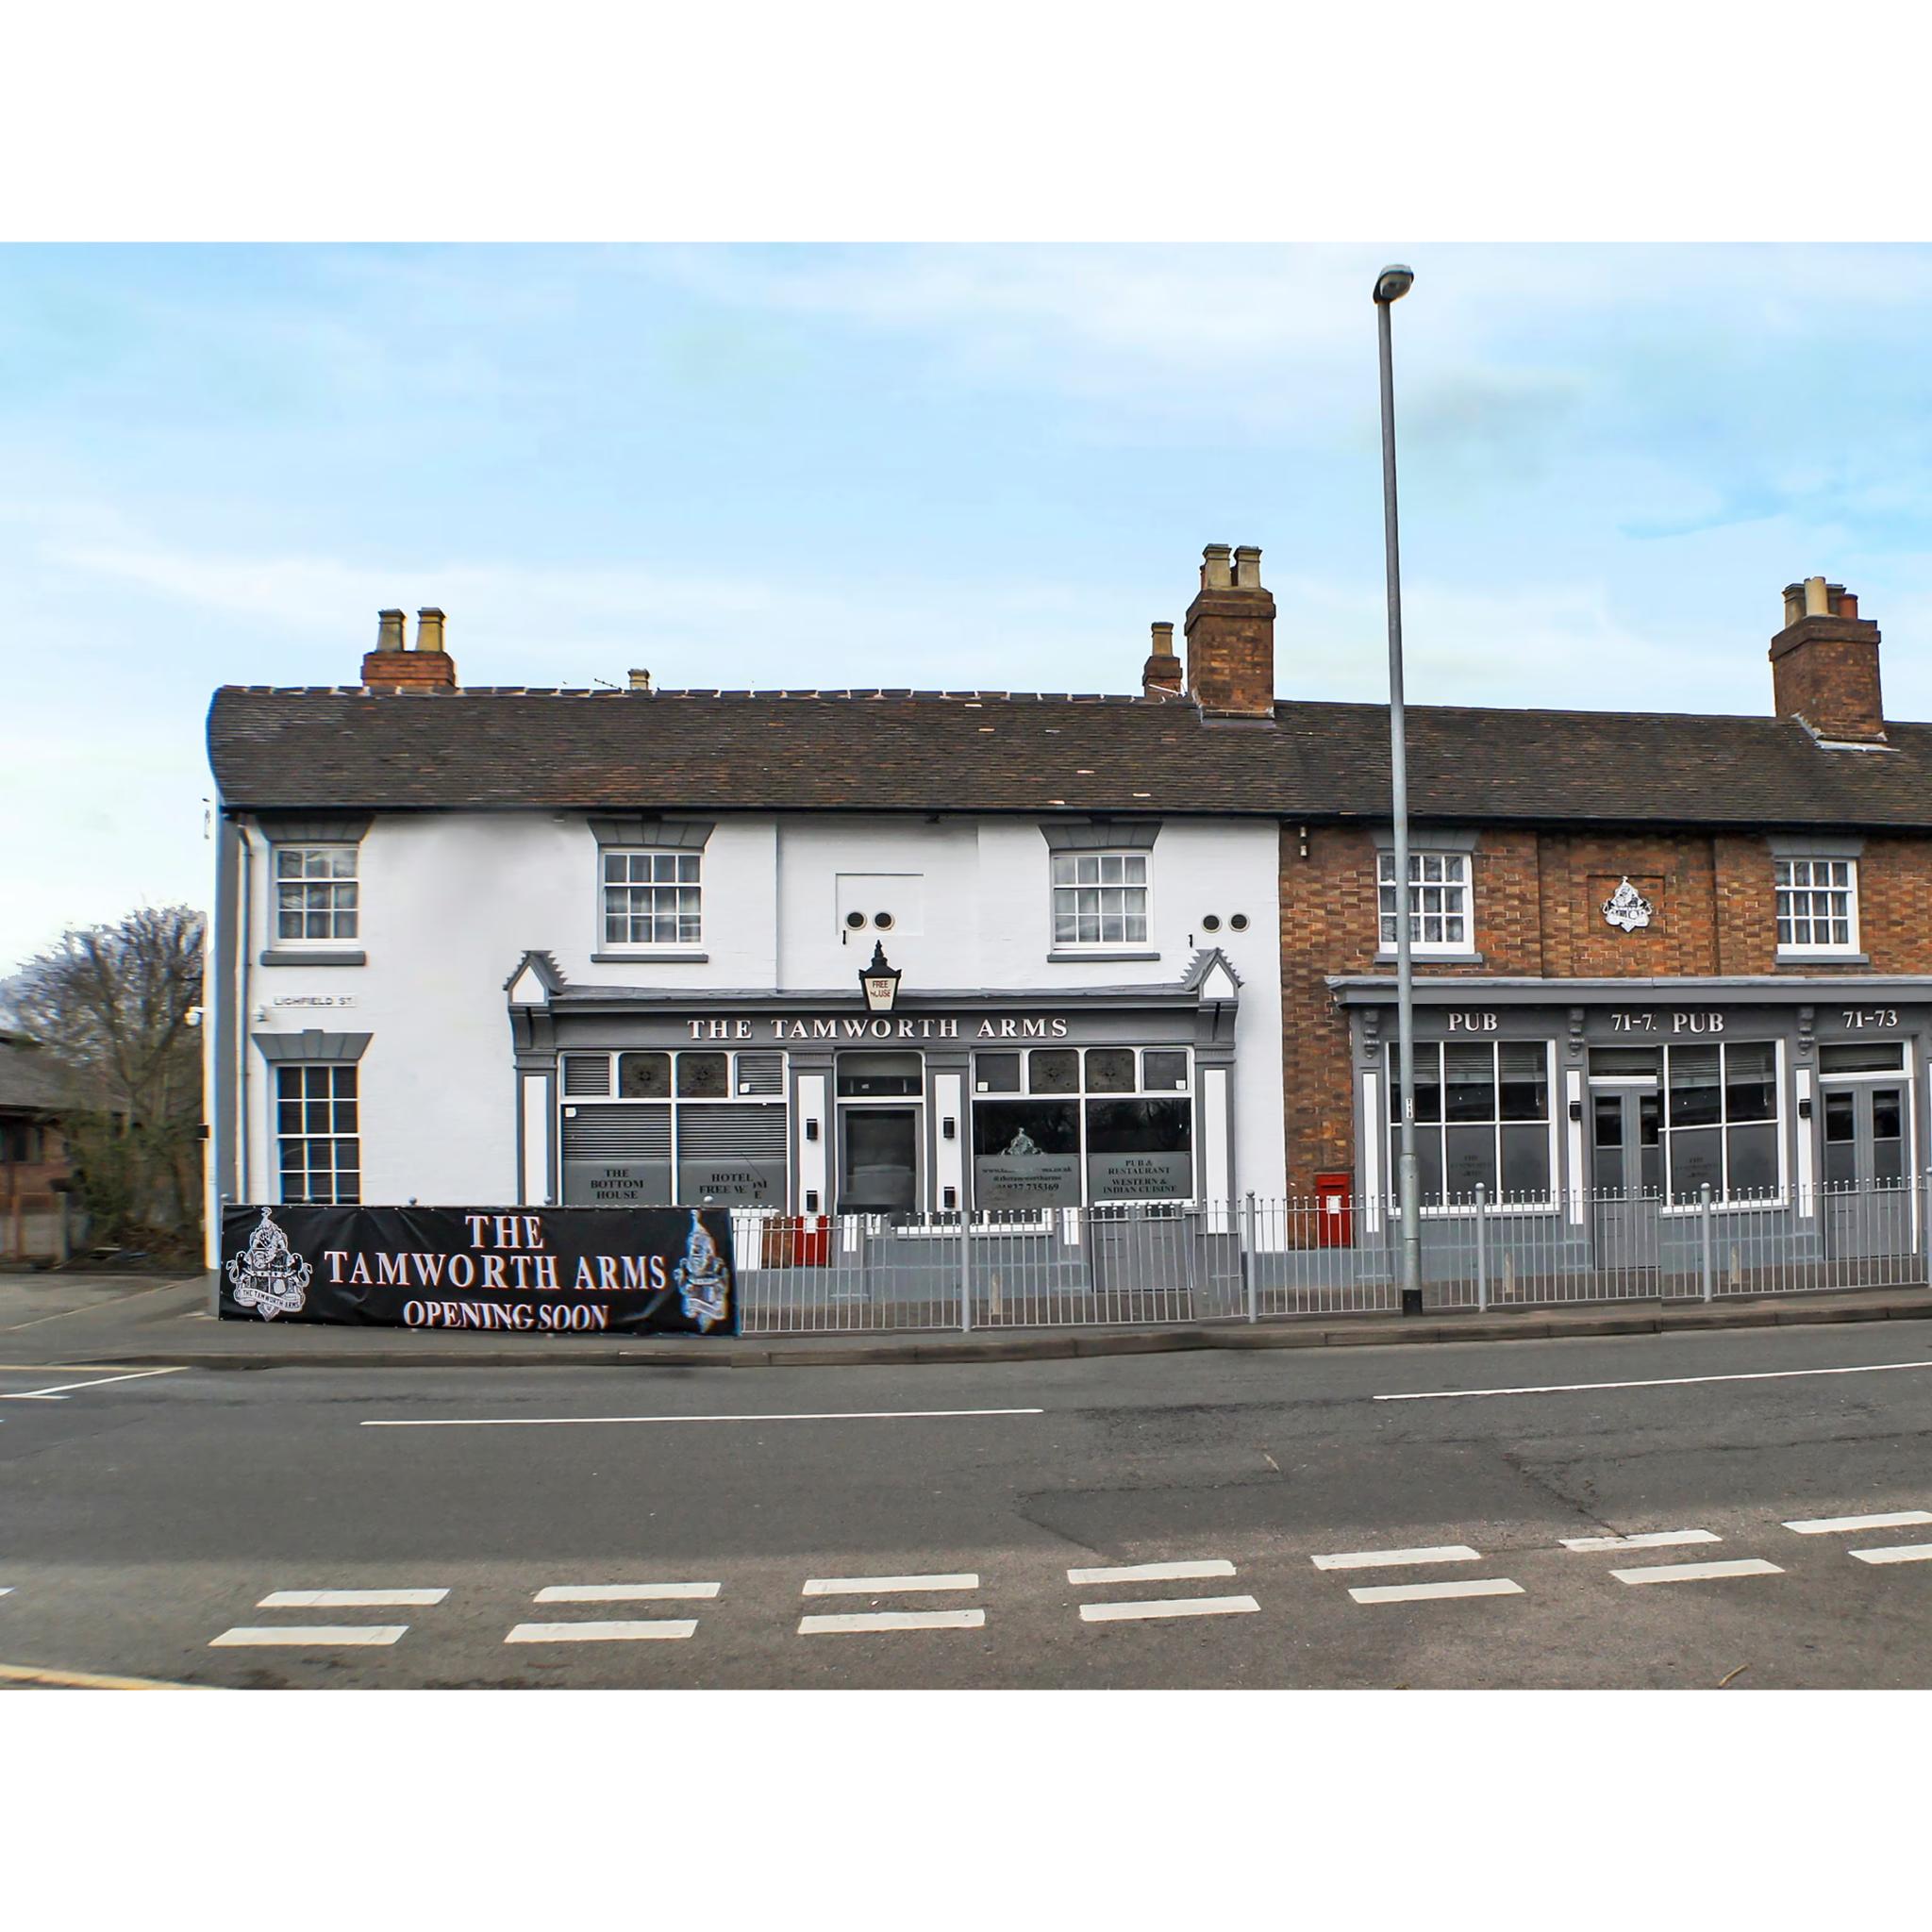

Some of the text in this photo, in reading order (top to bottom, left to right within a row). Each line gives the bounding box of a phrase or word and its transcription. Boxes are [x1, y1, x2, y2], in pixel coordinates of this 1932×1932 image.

[872, 980, 890, 989] FREE
[1448, 1012, 1498, 1031] PUB
[1672, 1012, 1725, 1034] PUB
[1842, 1009, 1899, 1028] 71-73
[688, 1018, 1070, 1040] THE TAMWORTH ARMS
[604, 1168, 630, 1179] THE
[1108, 1166, 1171, 1175] RESTAURANT
[711, 1172, 754, 1183] HOTEL
[1112, 1177, 1159, 1186] WESTERN
[591, 1179, 644, 1190] BOTTOM
[699, 1185, 731, 1194] FREE
[1103, 1186, 1139, 1194] INDIAN
[596, 1190, 639, 1200] HOUSE
[465, 1215, 545, 1249] THE
[324, 1250, 667, 1290] TAMWORTH ARMS
[242, 1289, 253, 1297] THE
[403, 1300, 609, 1331] OPENING SOON
